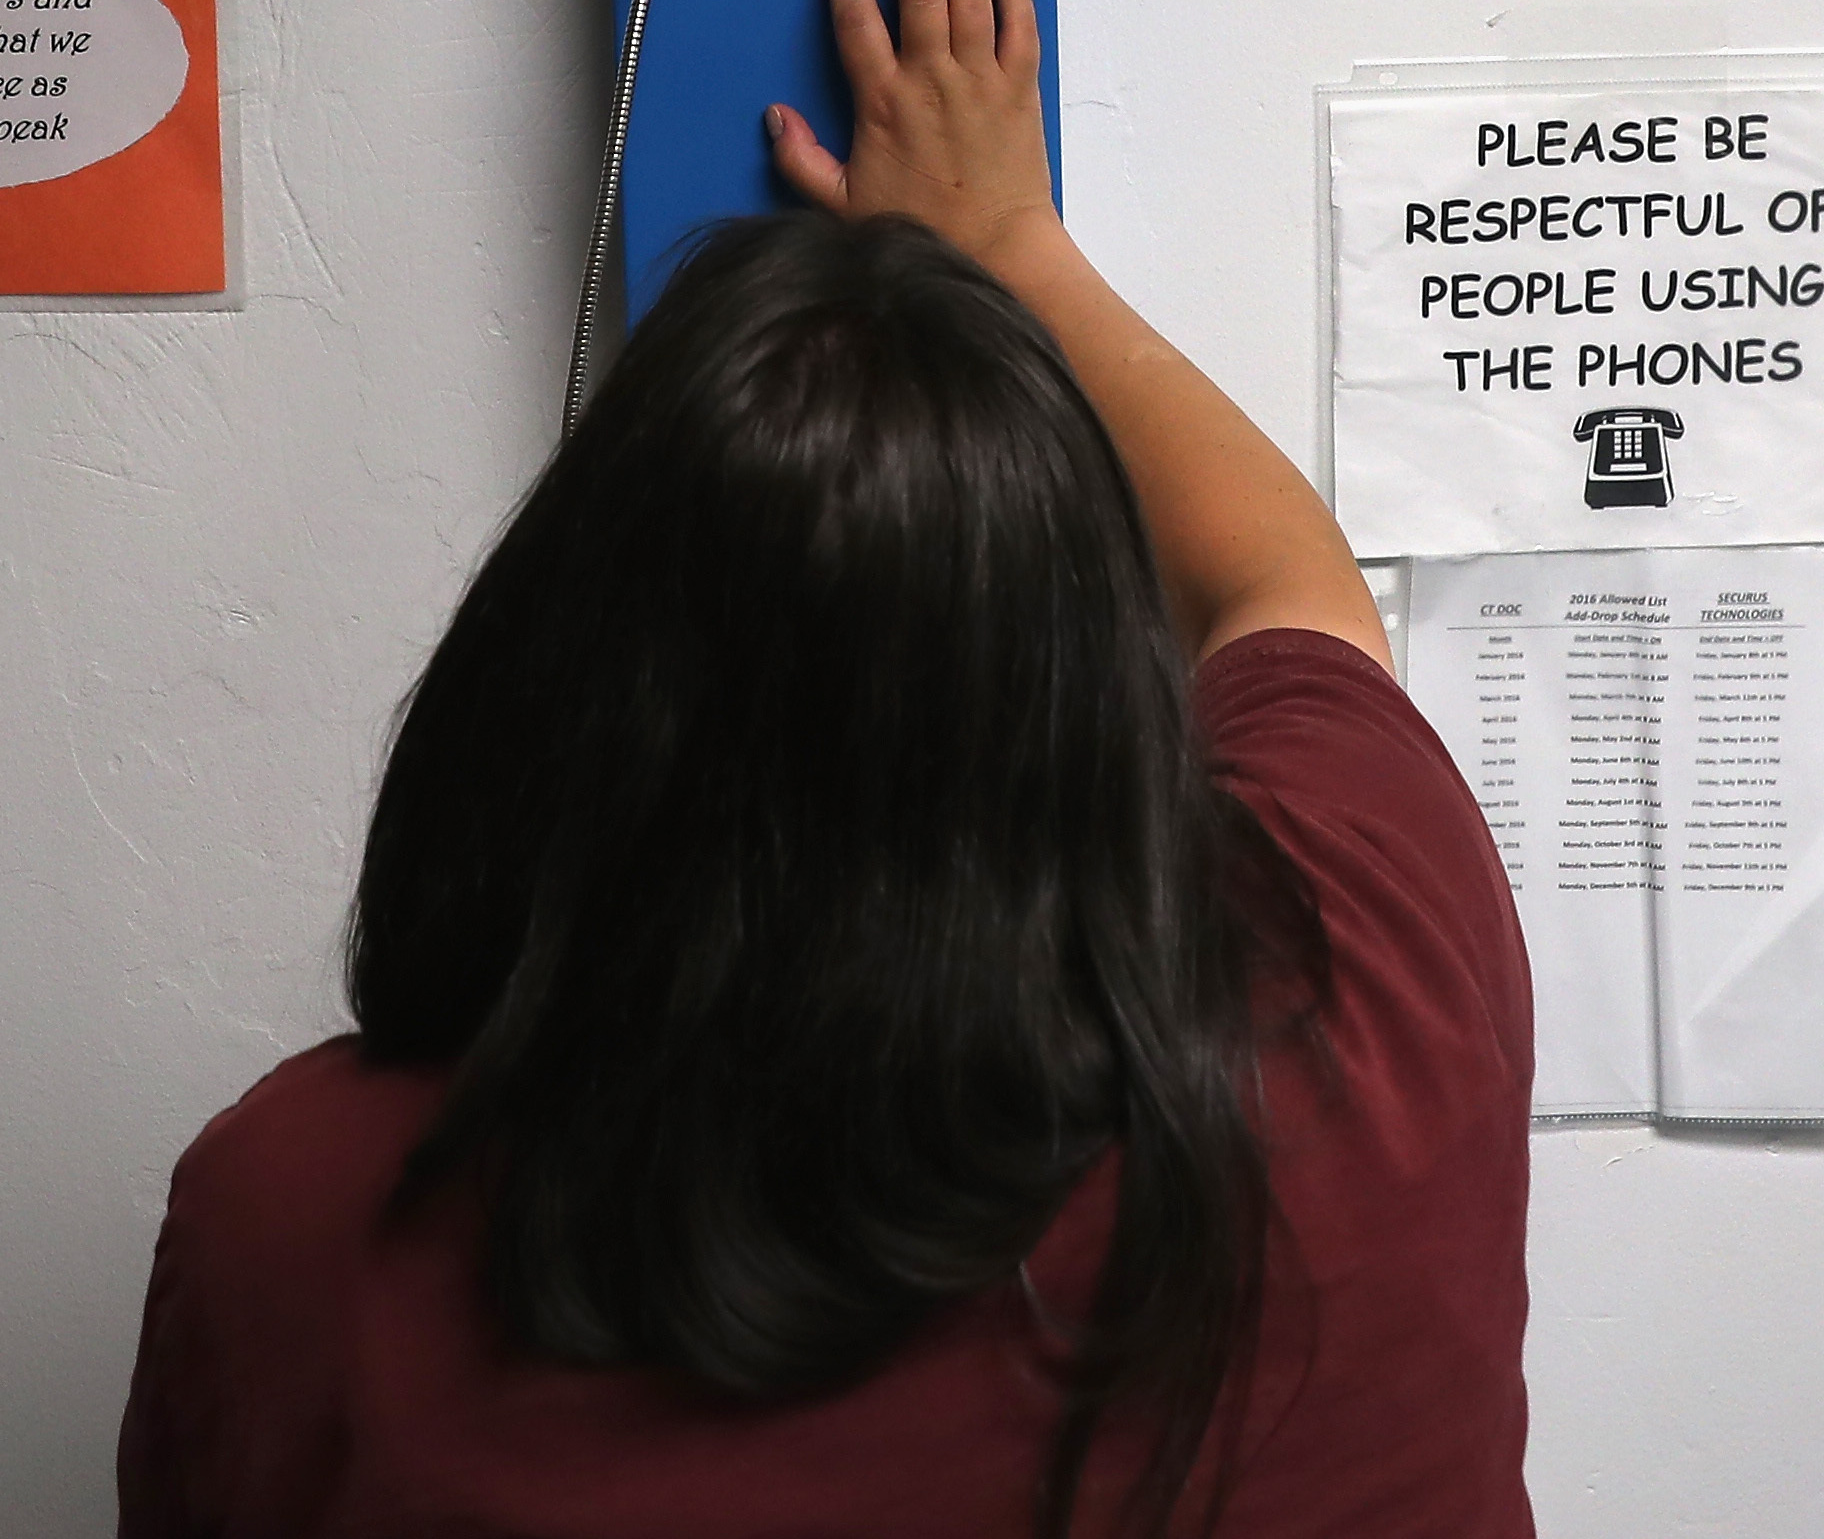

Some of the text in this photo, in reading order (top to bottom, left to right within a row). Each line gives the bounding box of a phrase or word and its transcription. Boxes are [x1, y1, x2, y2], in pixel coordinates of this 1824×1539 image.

[50, 30, 92, 57] we
[30, 76, 68, 97] as
[1478, 115, 1768, 167] PLEASE BE
[1406, 193, 1743, 244] RESPECTFUL
[1422, 264, 1824, 319] PEOPLE USING
[1443, 339, 1802, 391] THE PHONES
[1569, 593, 1667, 607] 2016 Allowed List
[1717, 592, 1769, 606] SECURUS
[1480, 603, 1523, 617] CT DOC
[1564, 610, 1671, 626] Add-Drop Schedule
[1700, 607, 1785, 623] TECHNOLOGIES
